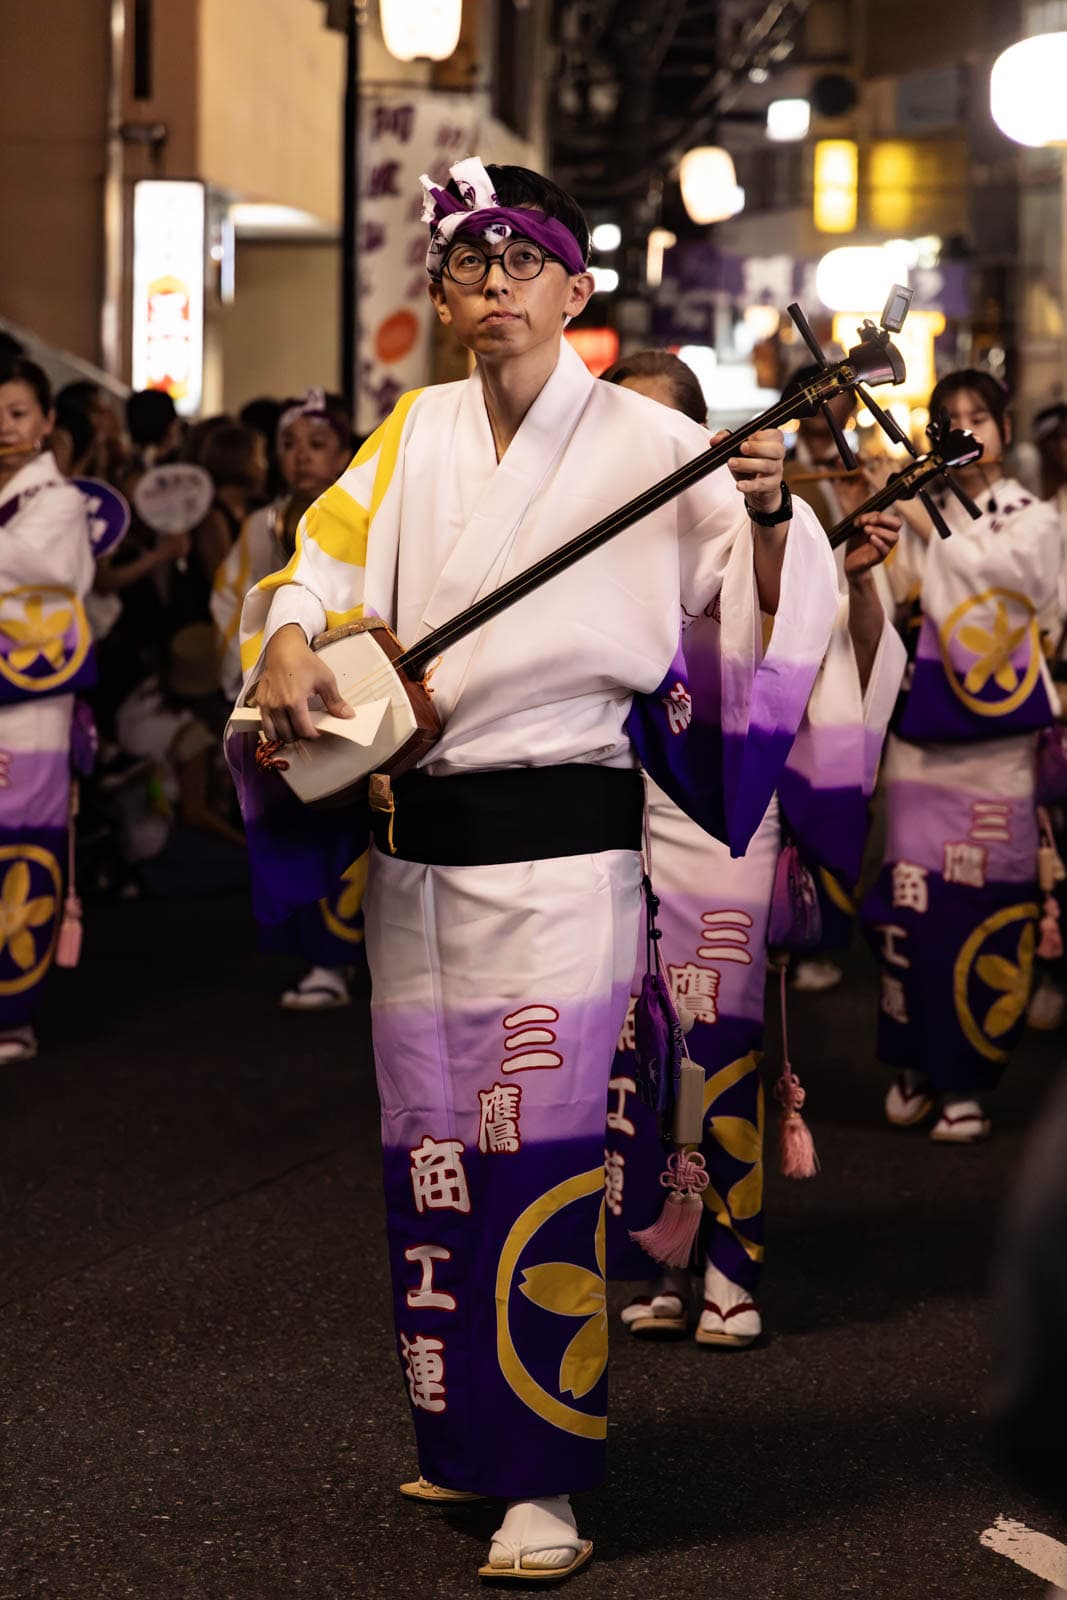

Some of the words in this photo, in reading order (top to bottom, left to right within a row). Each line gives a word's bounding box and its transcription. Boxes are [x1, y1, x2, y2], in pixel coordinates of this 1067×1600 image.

[668, 908, 754, 1026] 三鷹
[478, 1004, 563, 1154] 三鷹
[399, 1136, 471, 1414] 商工連
